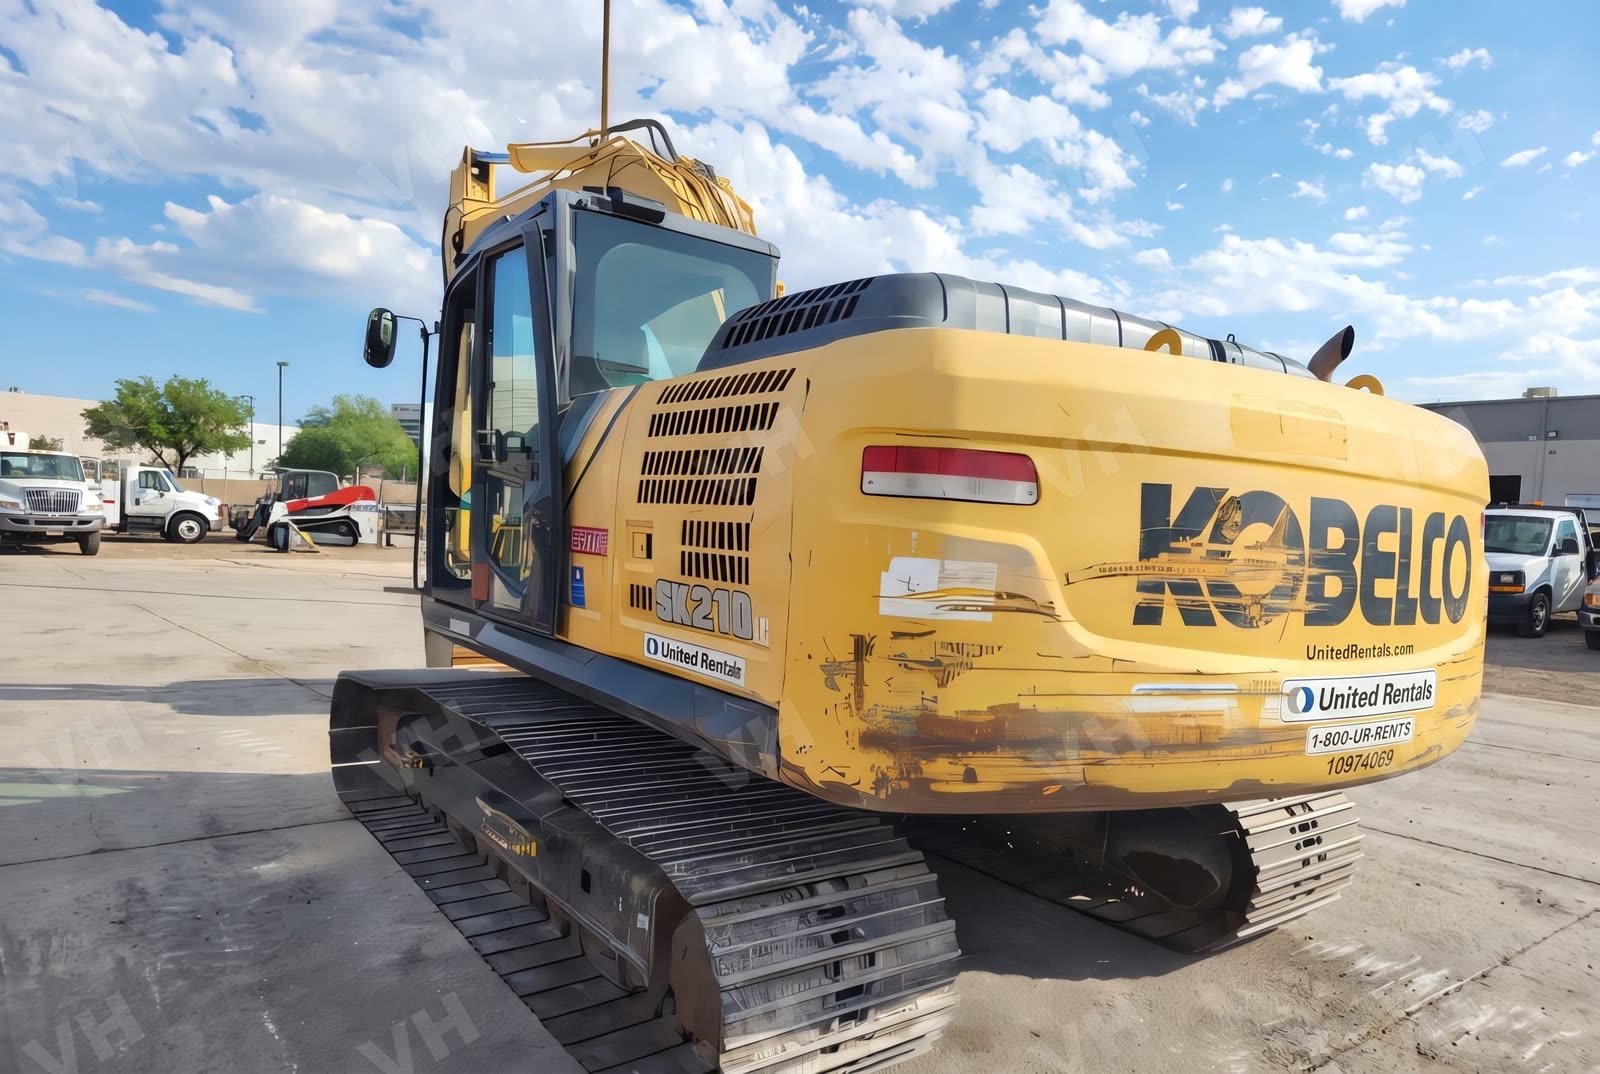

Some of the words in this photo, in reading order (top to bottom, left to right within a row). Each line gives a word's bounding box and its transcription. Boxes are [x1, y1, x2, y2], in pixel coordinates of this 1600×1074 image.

[1132, 484, 1471, 628] KOBELCO
[656, 579, 753, 640] SK210
[661, 643, 698, 666] United
[1306, 643, 1414, 660] UnitedRentals.com
[1319, 684, 1379, 712] United
[1382, 680, 1433, 705] Rentals
[1312, 723, 1411, 748] 1-800-UR-RENTS
[1327, 751, 1394, 775] 10974069
